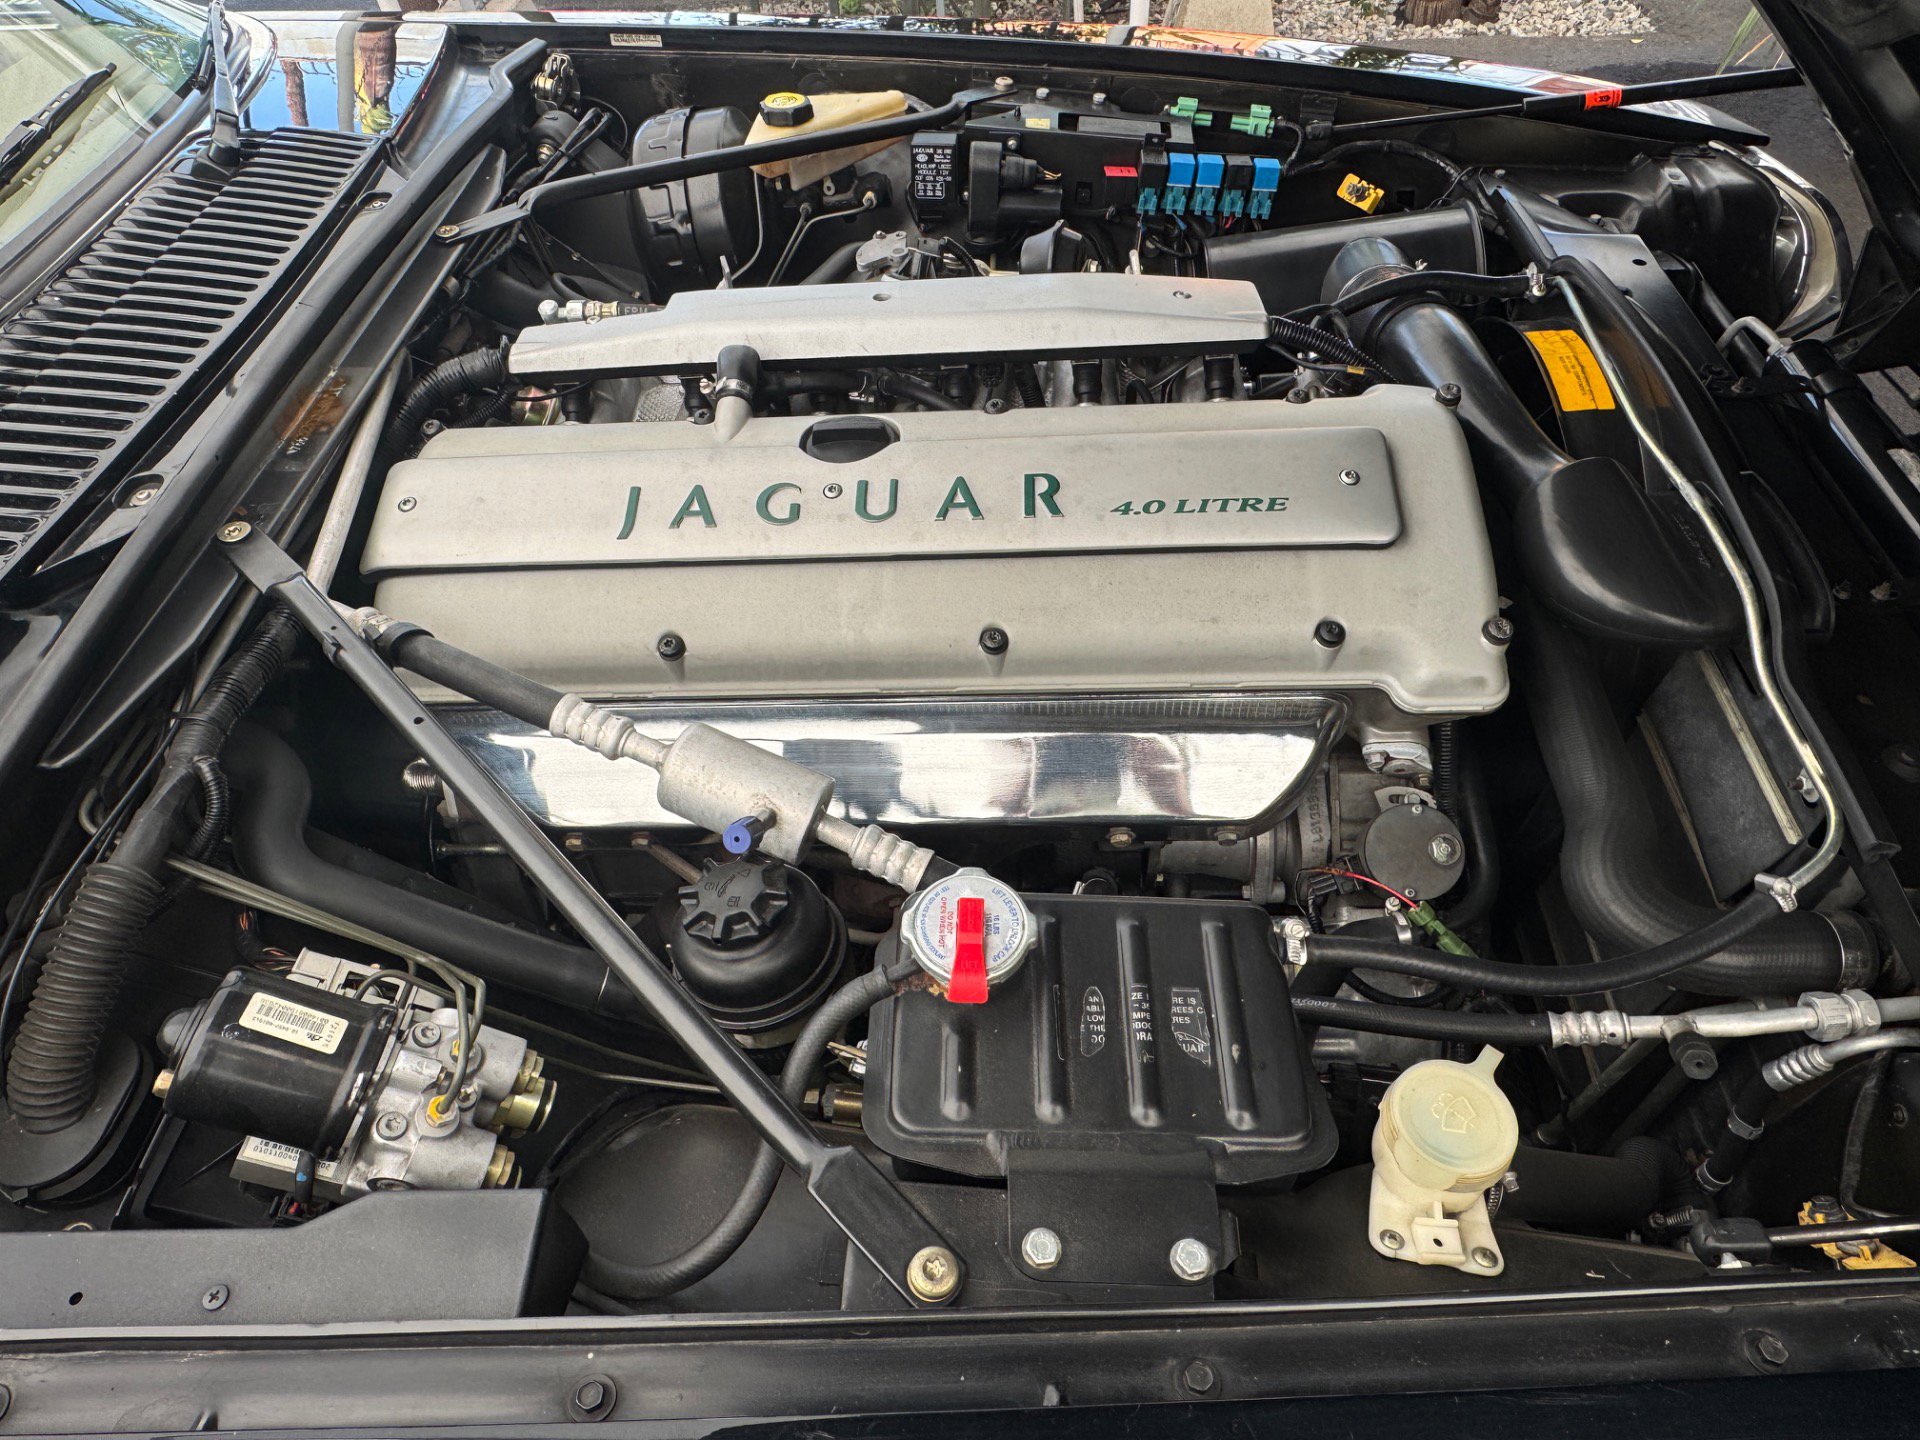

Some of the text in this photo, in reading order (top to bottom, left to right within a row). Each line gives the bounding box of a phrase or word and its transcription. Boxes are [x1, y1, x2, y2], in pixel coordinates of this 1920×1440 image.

[618, 472, 1065, 540] JAGUAR
[1110, 496, 1290, 516] 4.0 LITRE
[992, 887, 1006, 898] LIFT
[1003, 897, 1017, 917] LEVER
[947, 911, 954, 920] DO
[1012, 917, 1019, 927] TO
[938, 934, 947, 949] HOT
[992, 950, 1005, 963] CAP
